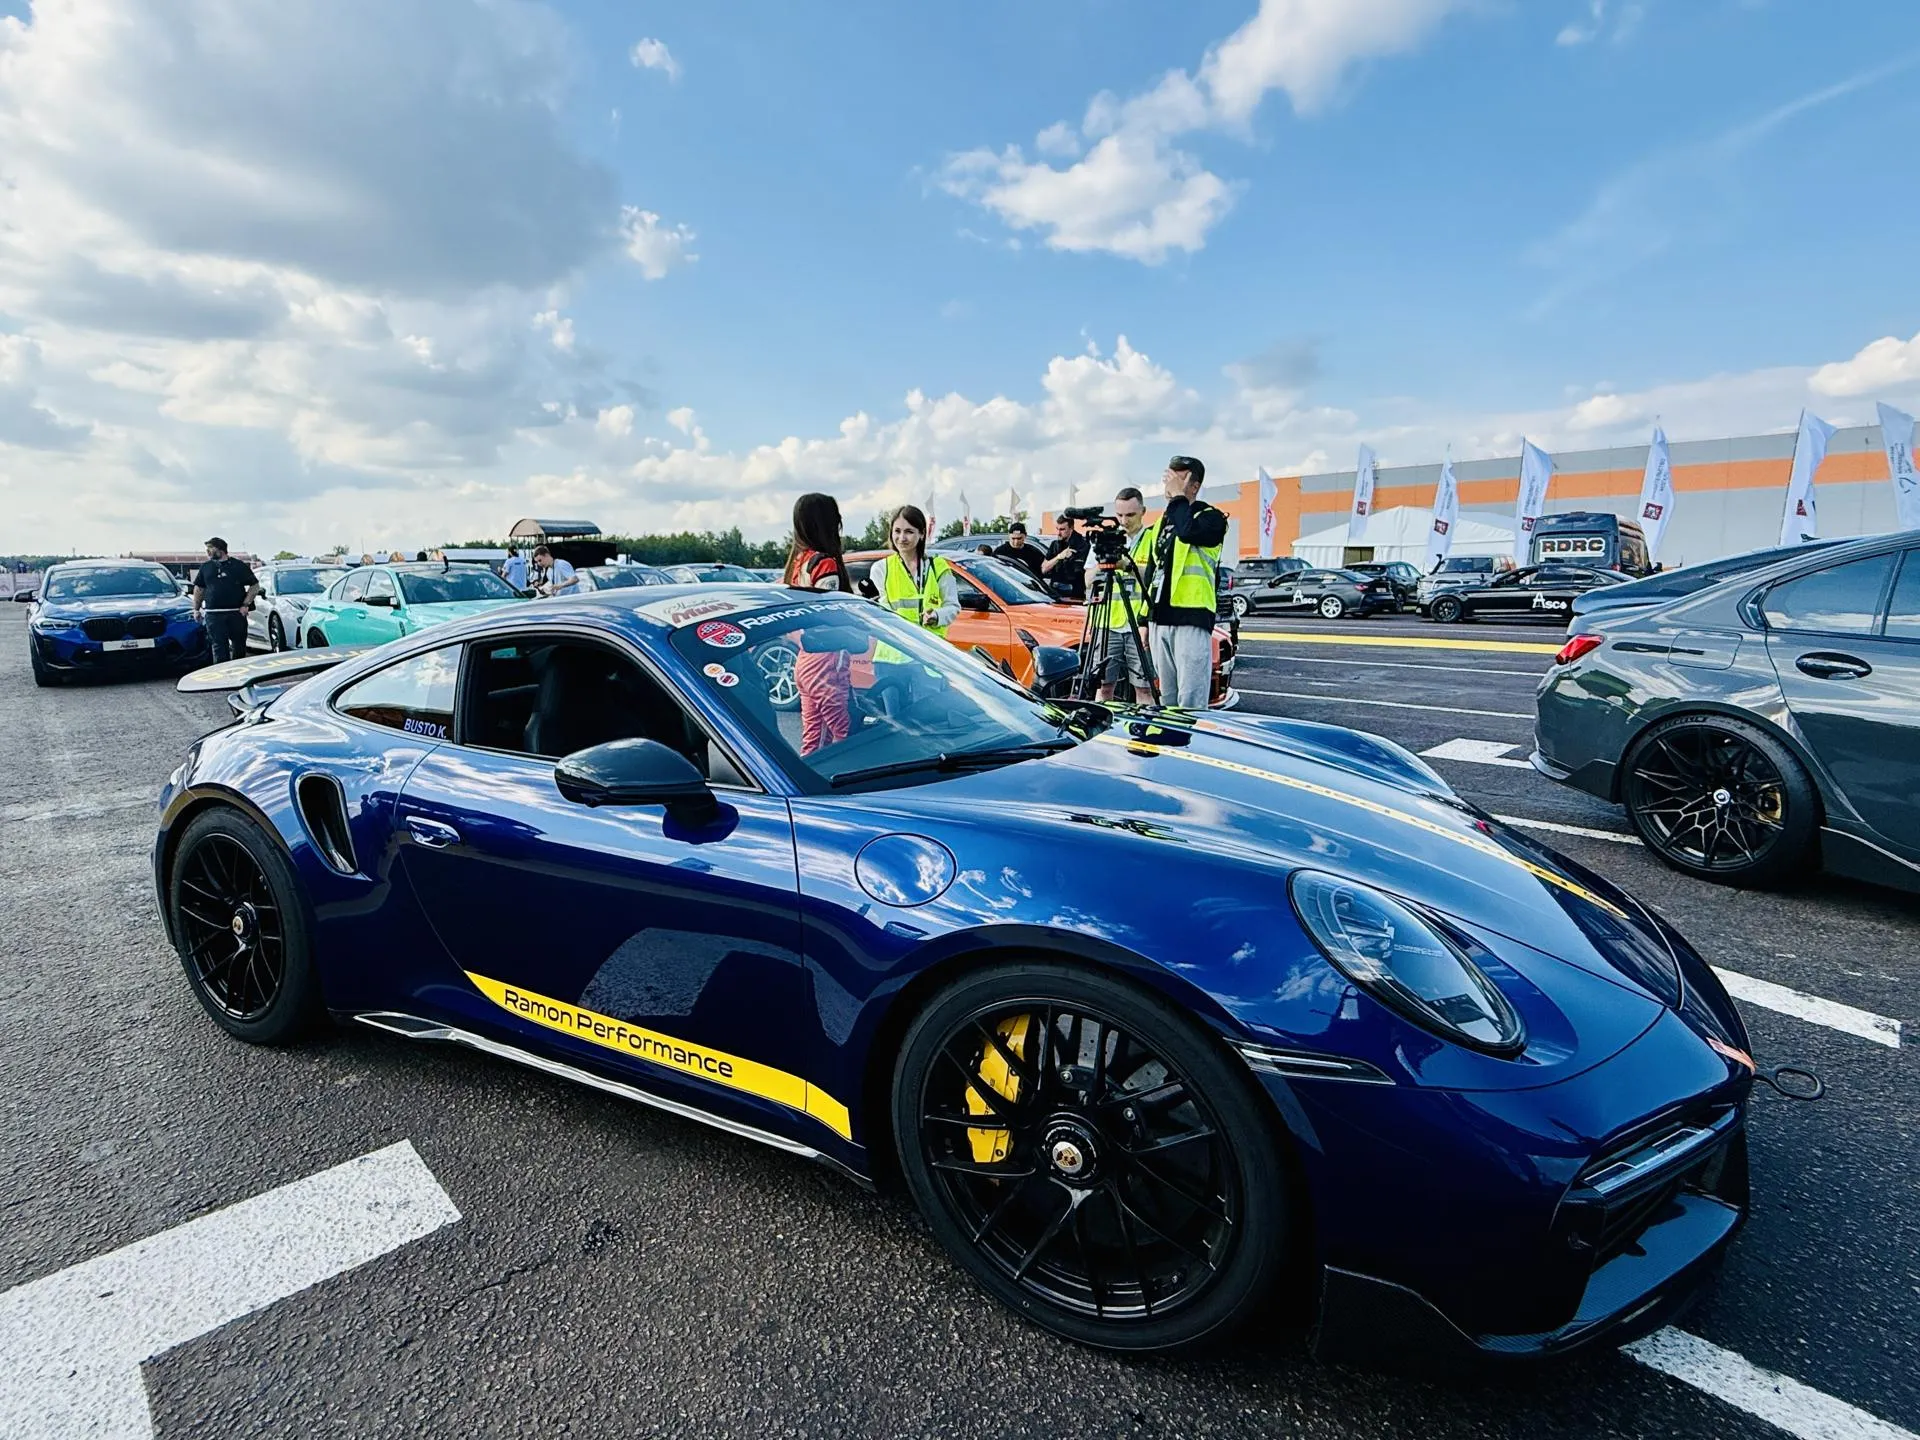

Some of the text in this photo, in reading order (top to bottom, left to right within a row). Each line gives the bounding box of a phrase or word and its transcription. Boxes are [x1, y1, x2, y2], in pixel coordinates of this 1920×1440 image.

[1539, 537, 1605, 555] RDRC
[738, 604, 812, 630] Ramon
[403, 717, 447, 739] BUSTO K.
[504, 988, 733, 1079] Ramon Performance
